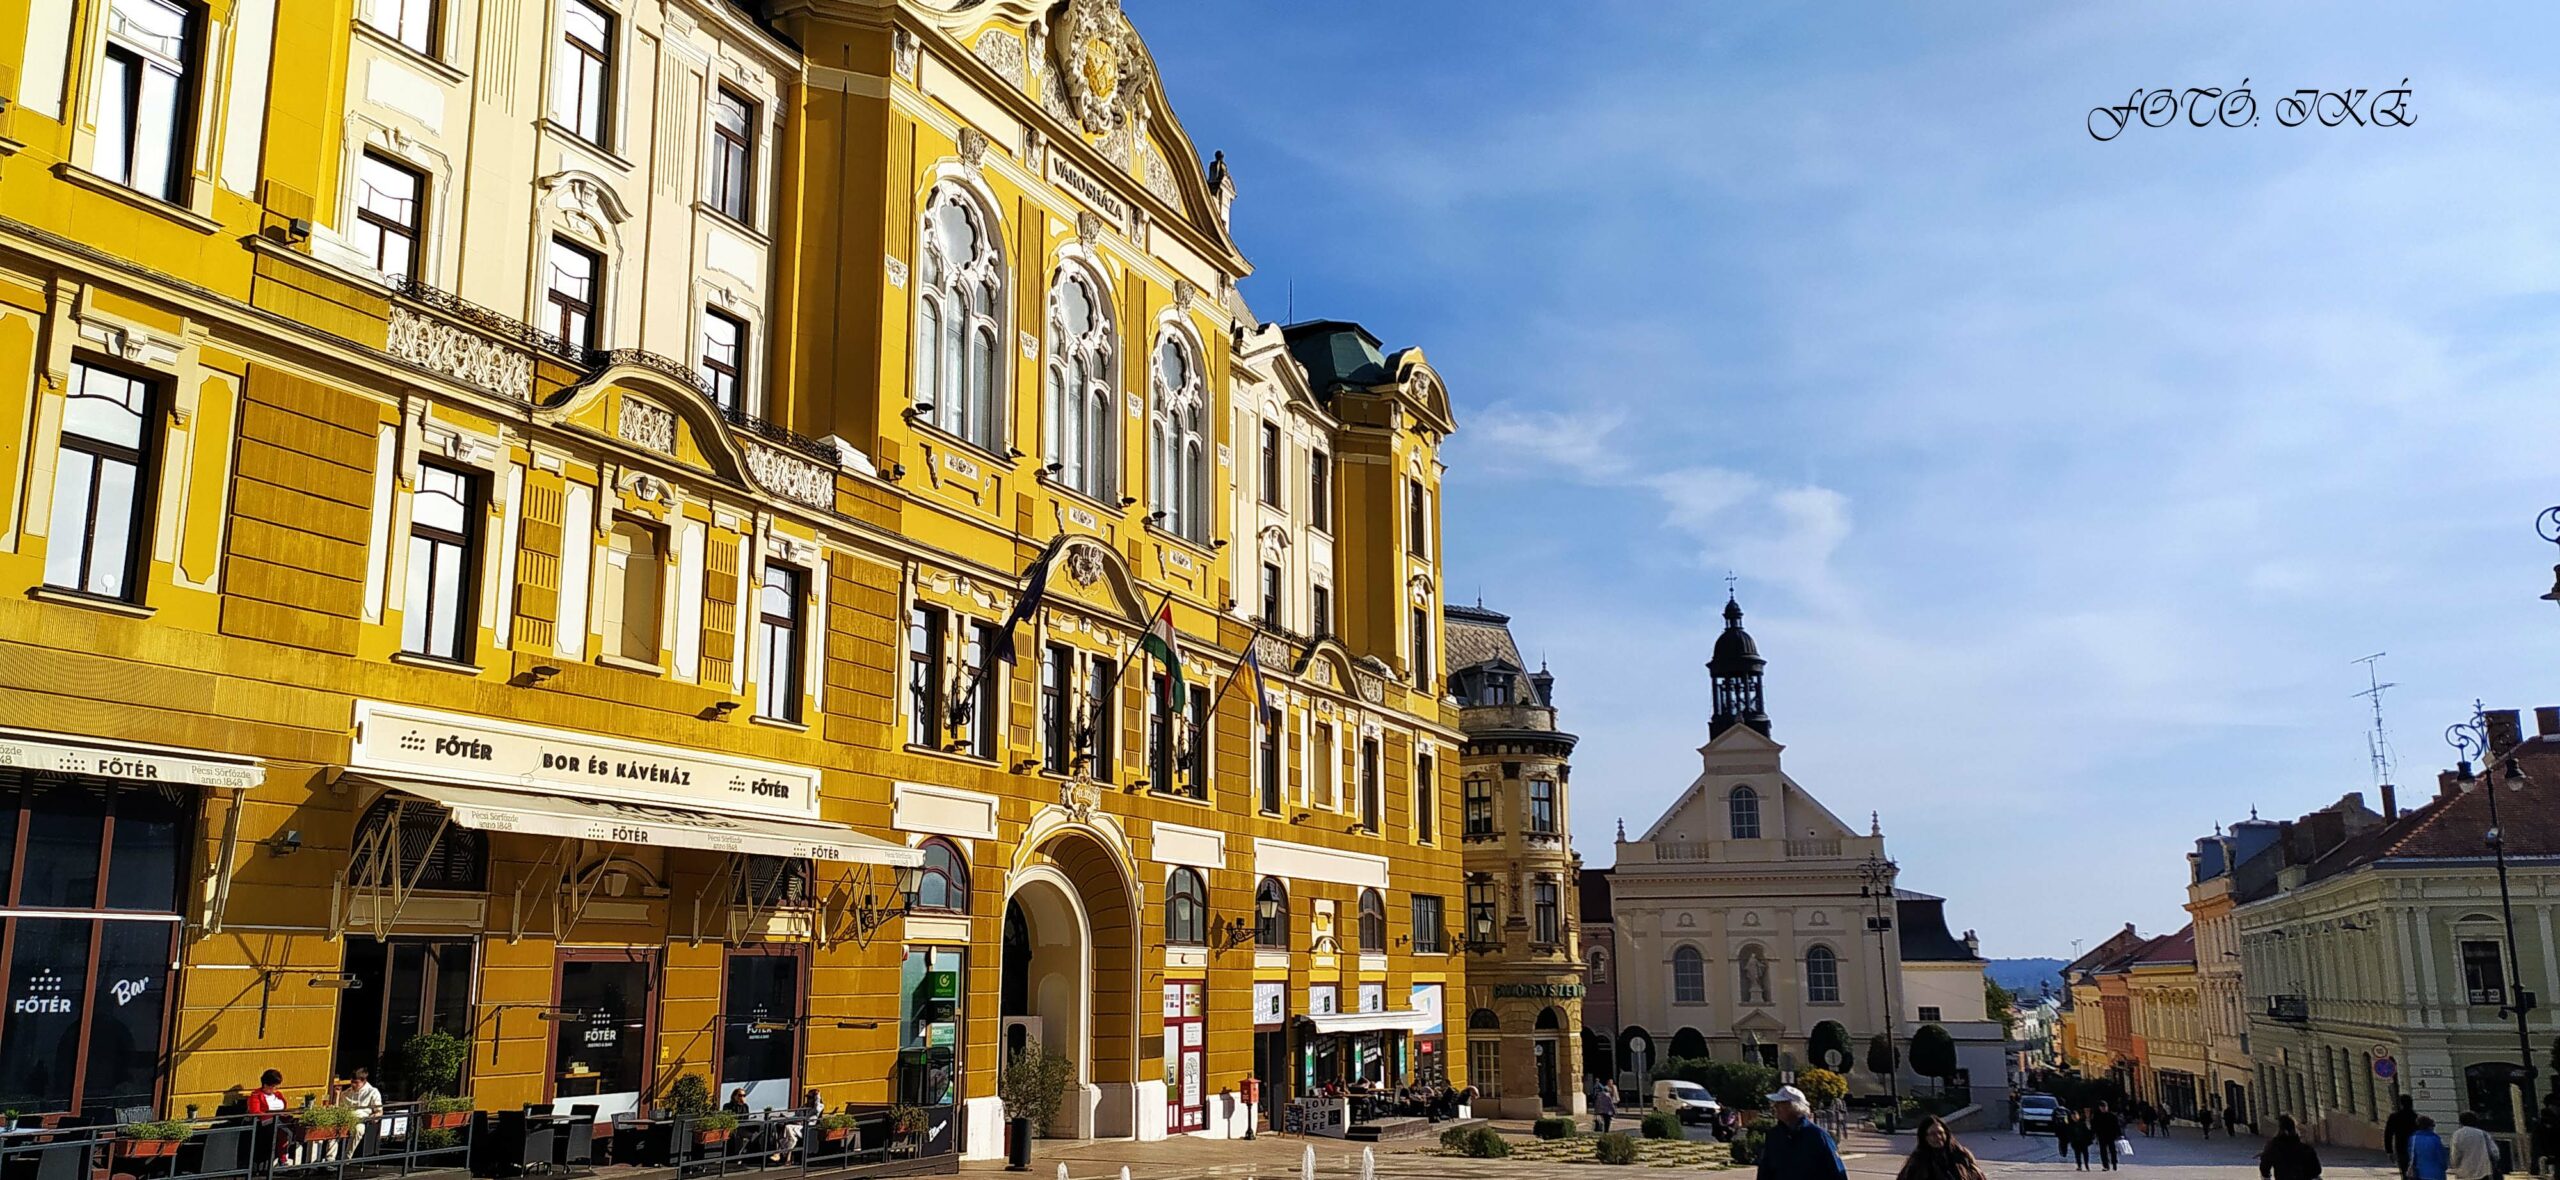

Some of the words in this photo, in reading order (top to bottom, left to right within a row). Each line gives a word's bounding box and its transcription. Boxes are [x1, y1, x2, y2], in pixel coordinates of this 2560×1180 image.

[1053, 157, 1123, 221] VÁROSHÁZA
[435, 735, 493, 761] FŐTÉR
[98, 757, 158, 779] FŐTÉR
[542, 753, 580, 772] BOR
[588, 755, 608, 775] ÉS
[616, 761, 691, 786] KÁVÉHÁZ
[751, 778, 790, 799] FŐTÉR
[611, 826, 649, 843] FŐTÉR
[811, 845, 840, 860] FŐTÉR
[110, 976, 150, 1006] Bar
[14, 996, 71, 1014] FŐTÉR
[584, 1027, 617, 1041] FŐTÉR
[1305, 1100, 1334, 1110] LOVE
[1305, 1110, 1326, 1121] ÉCS
[1305, 1122, 1325, 1131] AFE
